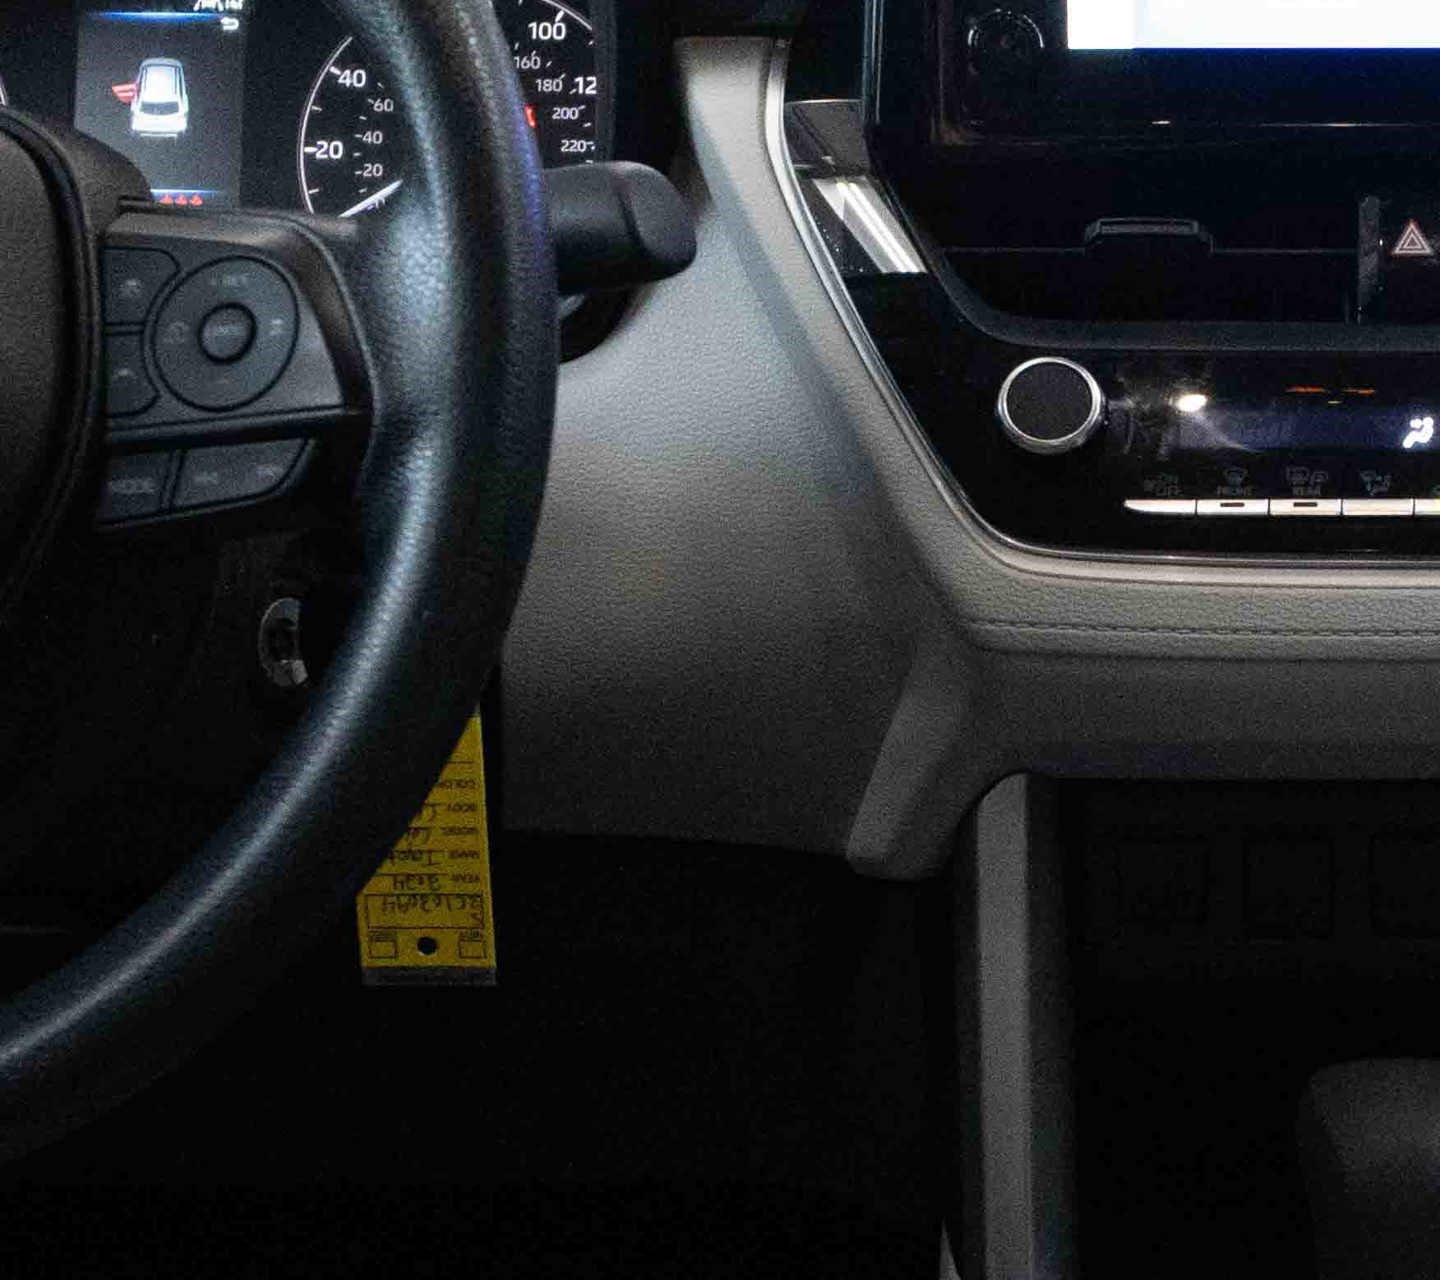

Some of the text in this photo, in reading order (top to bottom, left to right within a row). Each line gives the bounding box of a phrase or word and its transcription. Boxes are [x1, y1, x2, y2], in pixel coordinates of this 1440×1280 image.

[528, 22, 566, 40] 100
[514, 56, 541, 70] 160
[338, 69, 367, 88] 40
[536, 79, 563, 92] 180
[574, 76, 598, 95] 12
[373, 99, 394, 112] 60
[552, 107, 579, 120] 200
[362, 130, 384, 144] 40
[316, 141, 344, 159] 20
[560, 140, 587, 152] 220
[362, 163, 384, 177] 20
